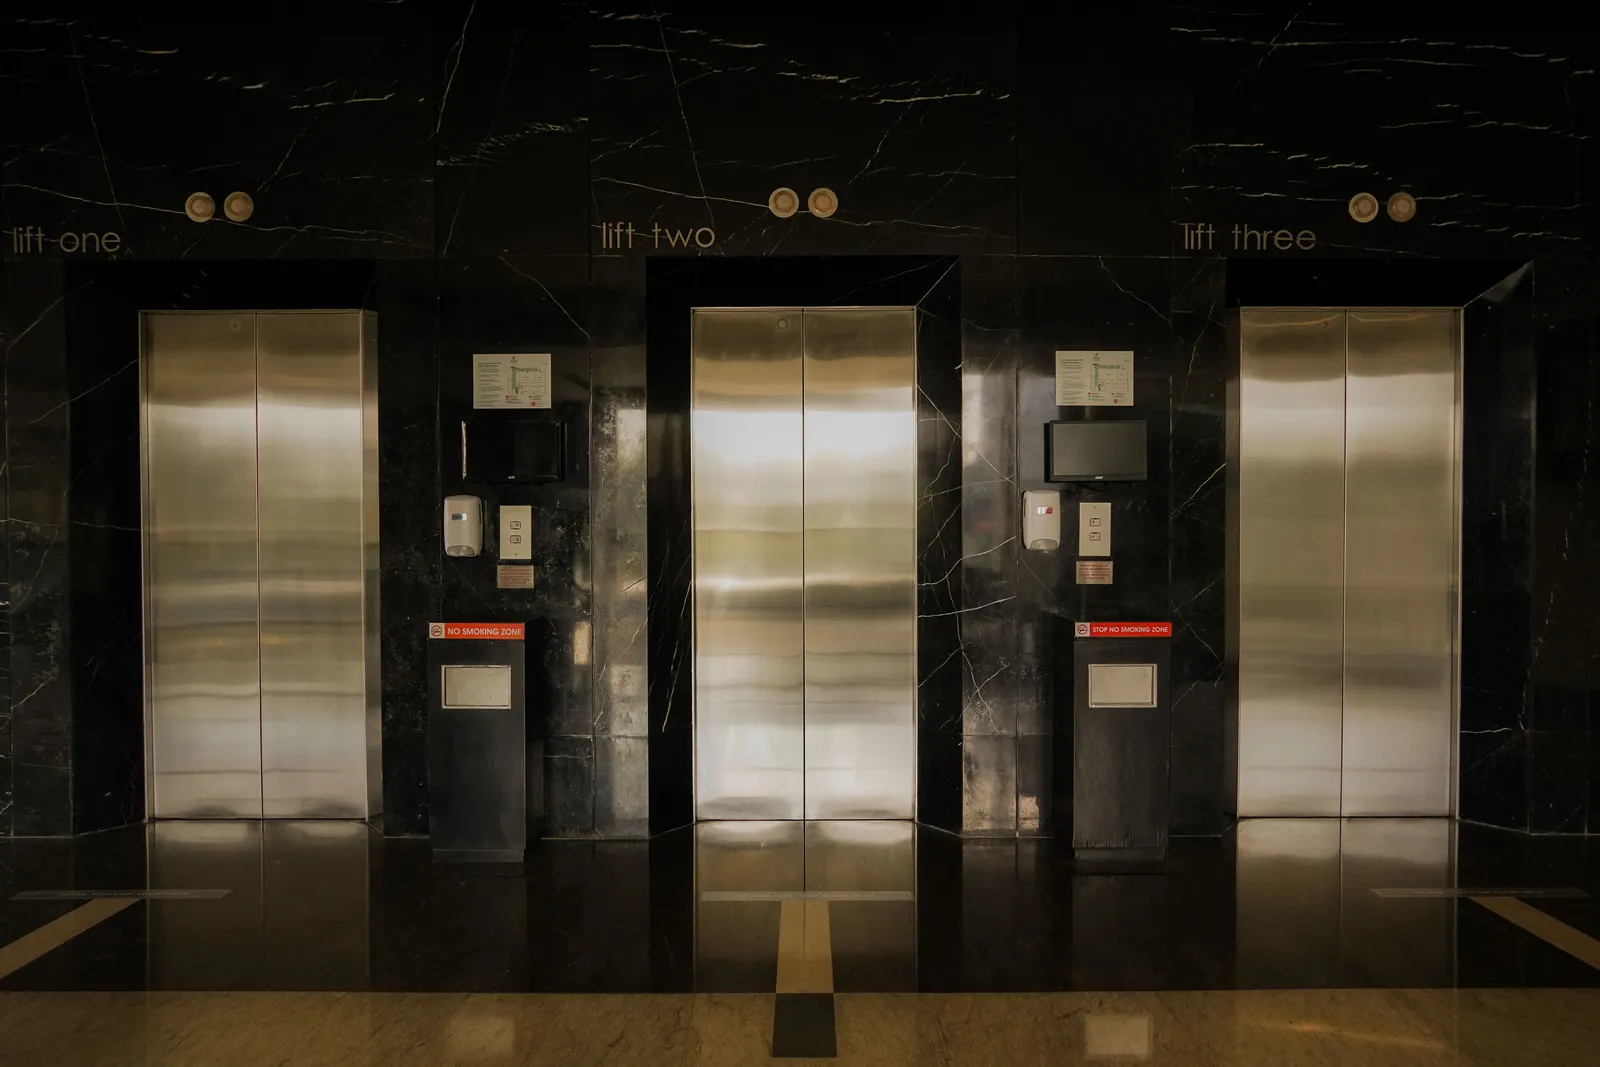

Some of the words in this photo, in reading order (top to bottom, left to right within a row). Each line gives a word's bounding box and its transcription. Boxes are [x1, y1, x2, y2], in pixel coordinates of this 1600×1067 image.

[13, 226, 45, 253] lift
[59, 232, 121, 253] one
[602, 221, 635, 249] lift
[651, 222, 715, 249] two
[1184, 223, 1216, 250] lift
[1231, 223, 1316, 250] three
[447, 627, 461, 635] NO
[462, 627, 500, 636] SMOKING
[501, 628, 522, 636] ZONE
